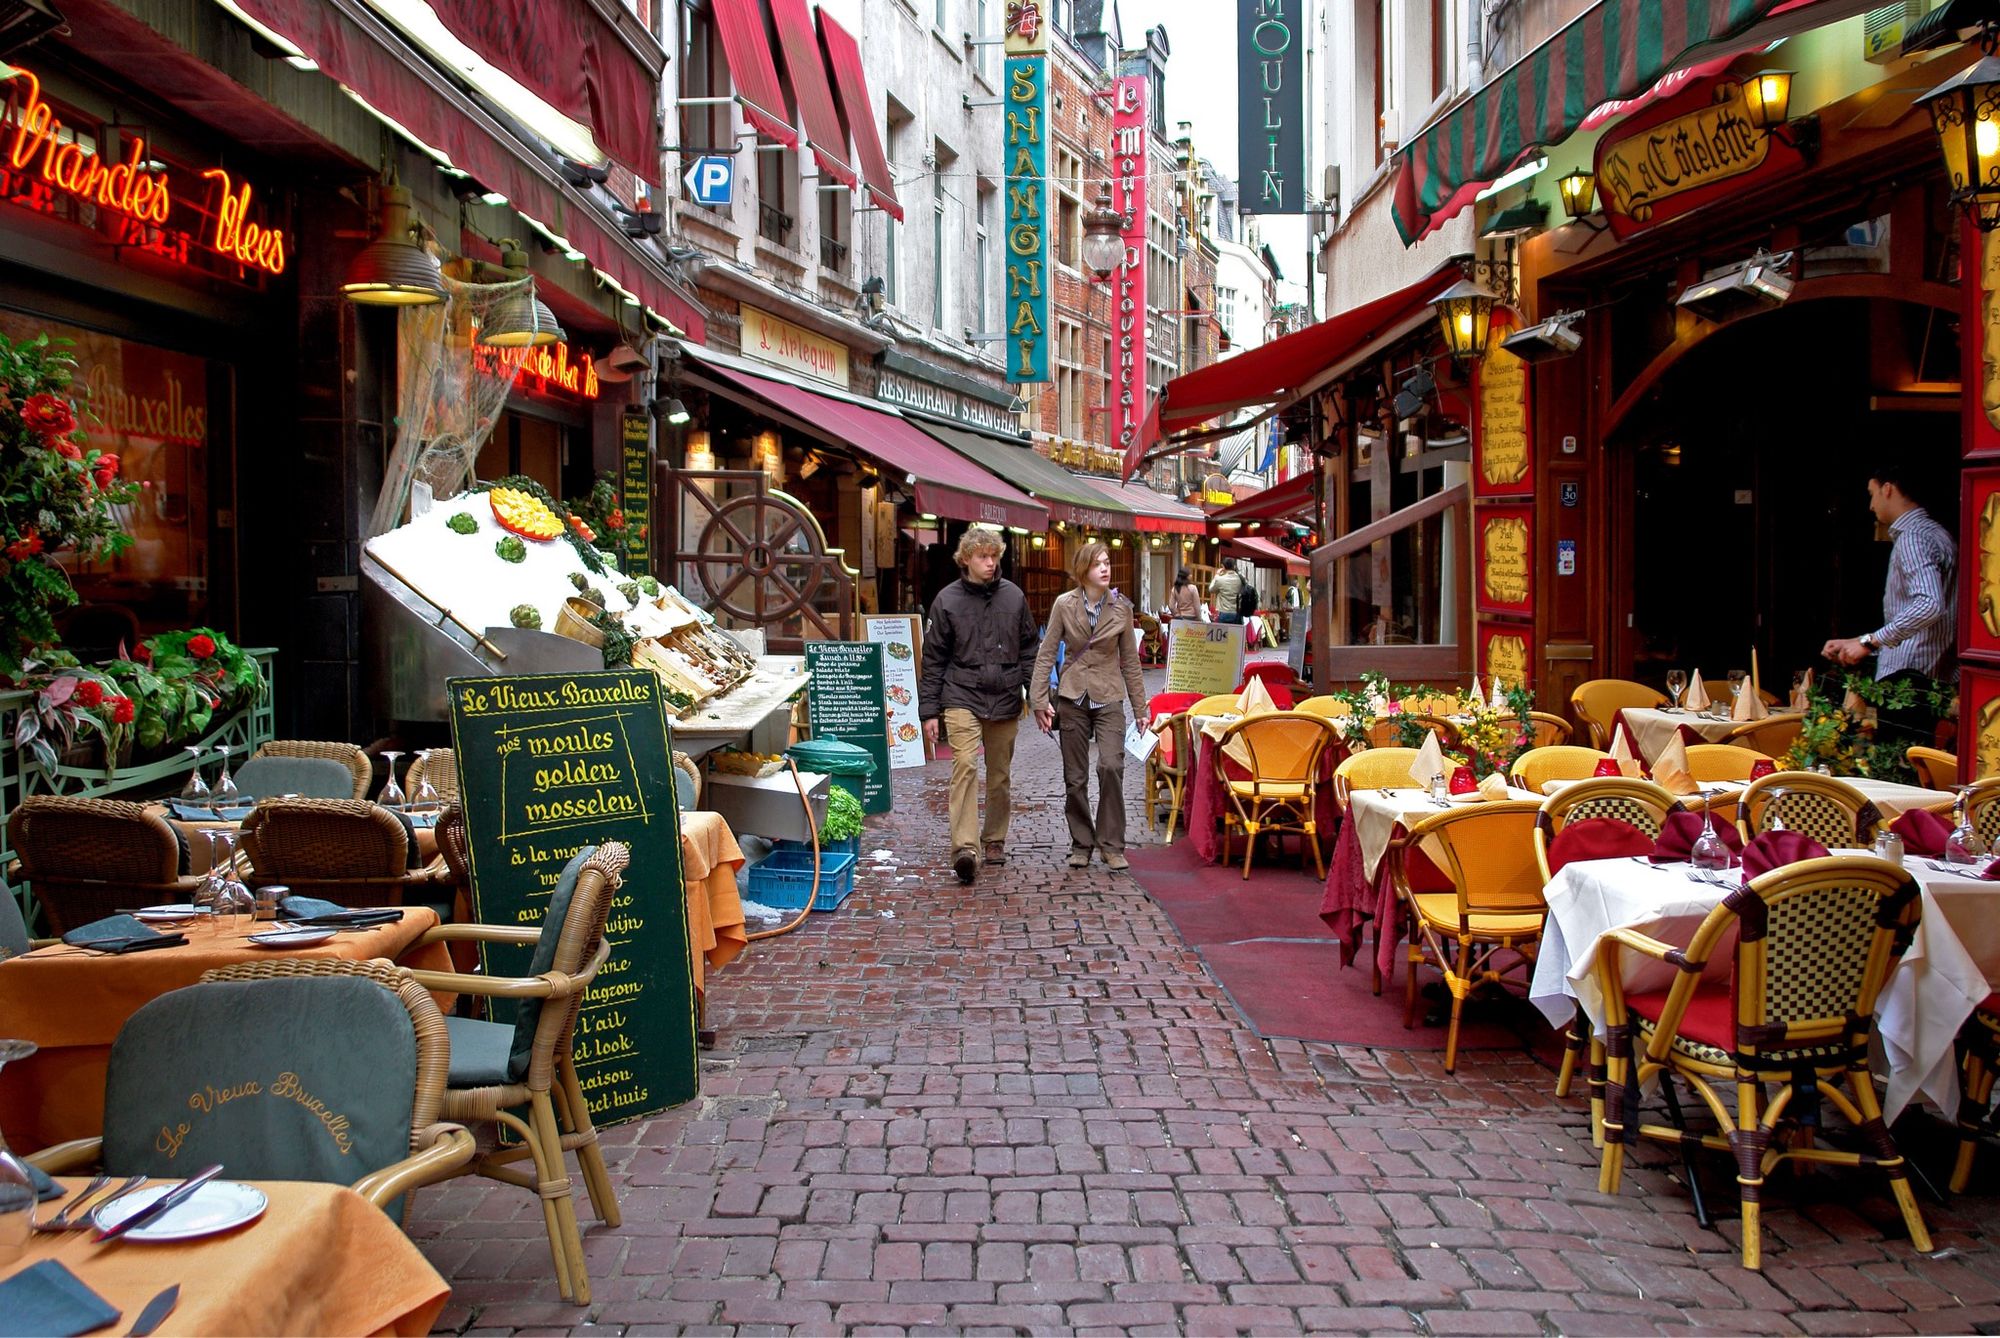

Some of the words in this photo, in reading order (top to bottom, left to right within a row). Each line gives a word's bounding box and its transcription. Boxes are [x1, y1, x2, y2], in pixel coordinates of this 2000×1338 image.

[1116, 79, 1142, 115] La
[6, 65, 170, 225] Viandes
[702, 163, 729, 198] P
[1009, 63, 1043, 376] SHANGHAI
[760, 317, 837, 379] L'Arlequin
[878, 370, 958, 417] RESTAURANT
[962, 397, 1021, 437] SHANGHAI
[1563, 490, 1577, 500] 30
[462, 684, 489, 713] Le
[490, 684, 560, 710] Vieux
[560, 678, 651, 706] Bruxelles
[496, 734, 522, 755] nos
[527, 725, 615, 756] moules
[534, 758, 622, 792] golden
[524, 788, 639, 822] mosselen
[511, 847, 527, 866] à
[528, 844, 552, 863] la
[517, 907, 542, 921] au
[581, 1009, 627, 1034] l'ail
[594, 1033, 634, 1056] look
[612, 1085, 648, 1108] huis
[155, 1121, 192, 1159] Le
[188, 1079, 264, 1113] Vieux
[270, 1070, 353, 1155] Bruxelles
